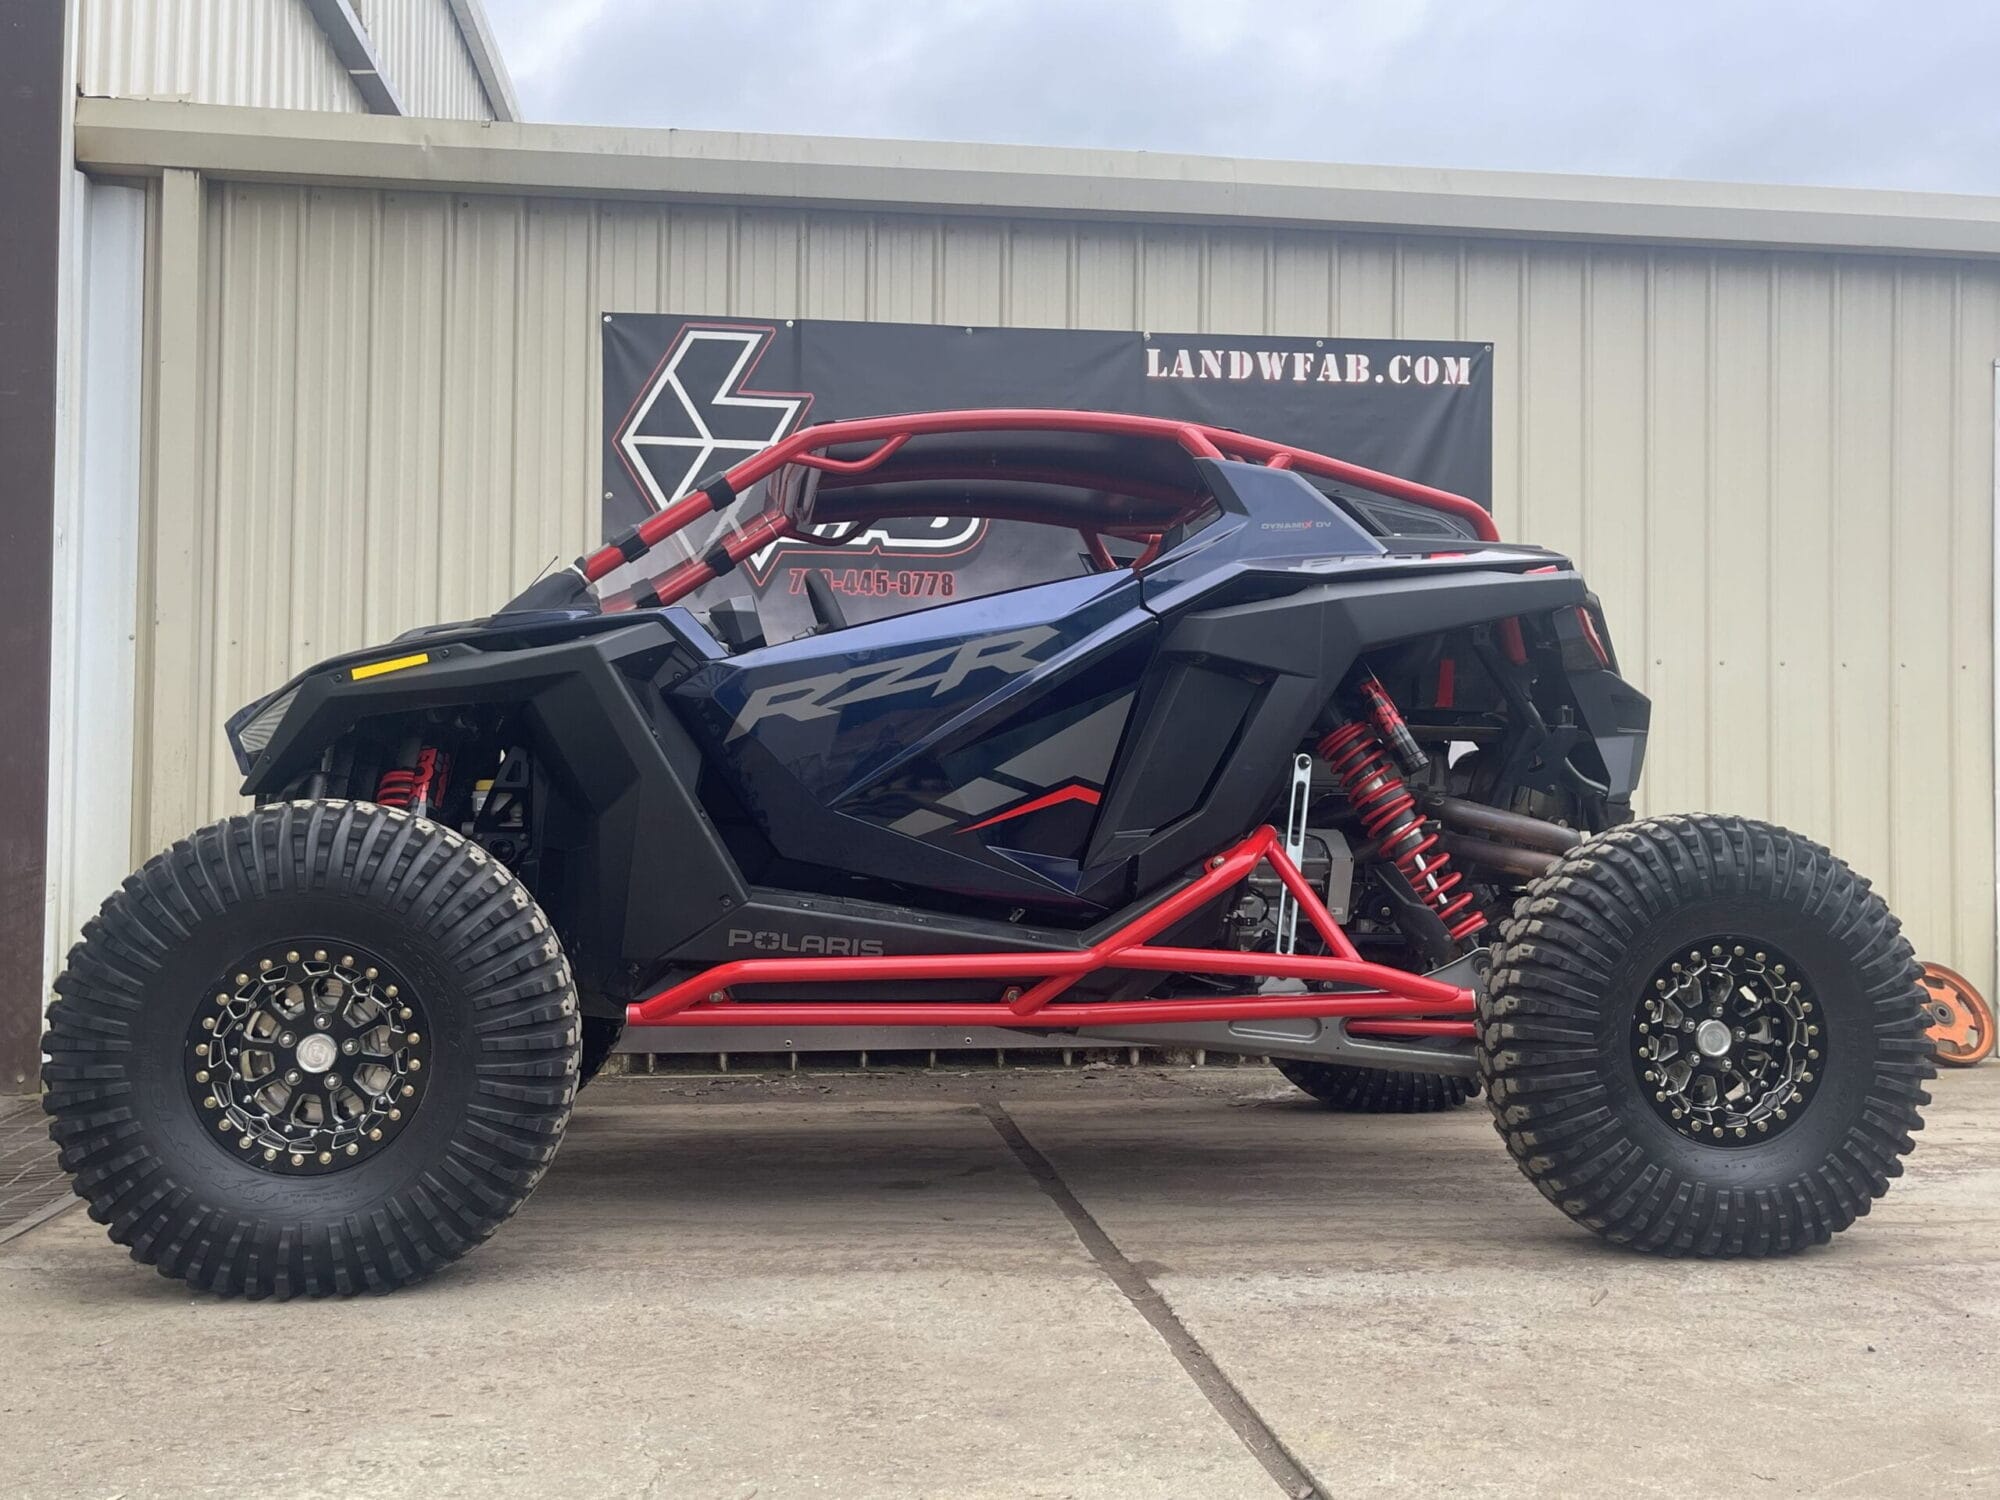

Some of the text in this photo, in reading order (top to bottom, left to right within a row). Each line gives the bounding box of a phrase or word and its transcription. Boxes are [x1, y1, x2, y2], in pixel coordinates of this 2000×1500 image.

[1145, 348, 1472, 386] LANDWFAB.COM
[789, 567, 955, 597] 7-445-9778
[723, 625, 1061, 746] RZR
[728, 928, 884, 956] POLARIS
